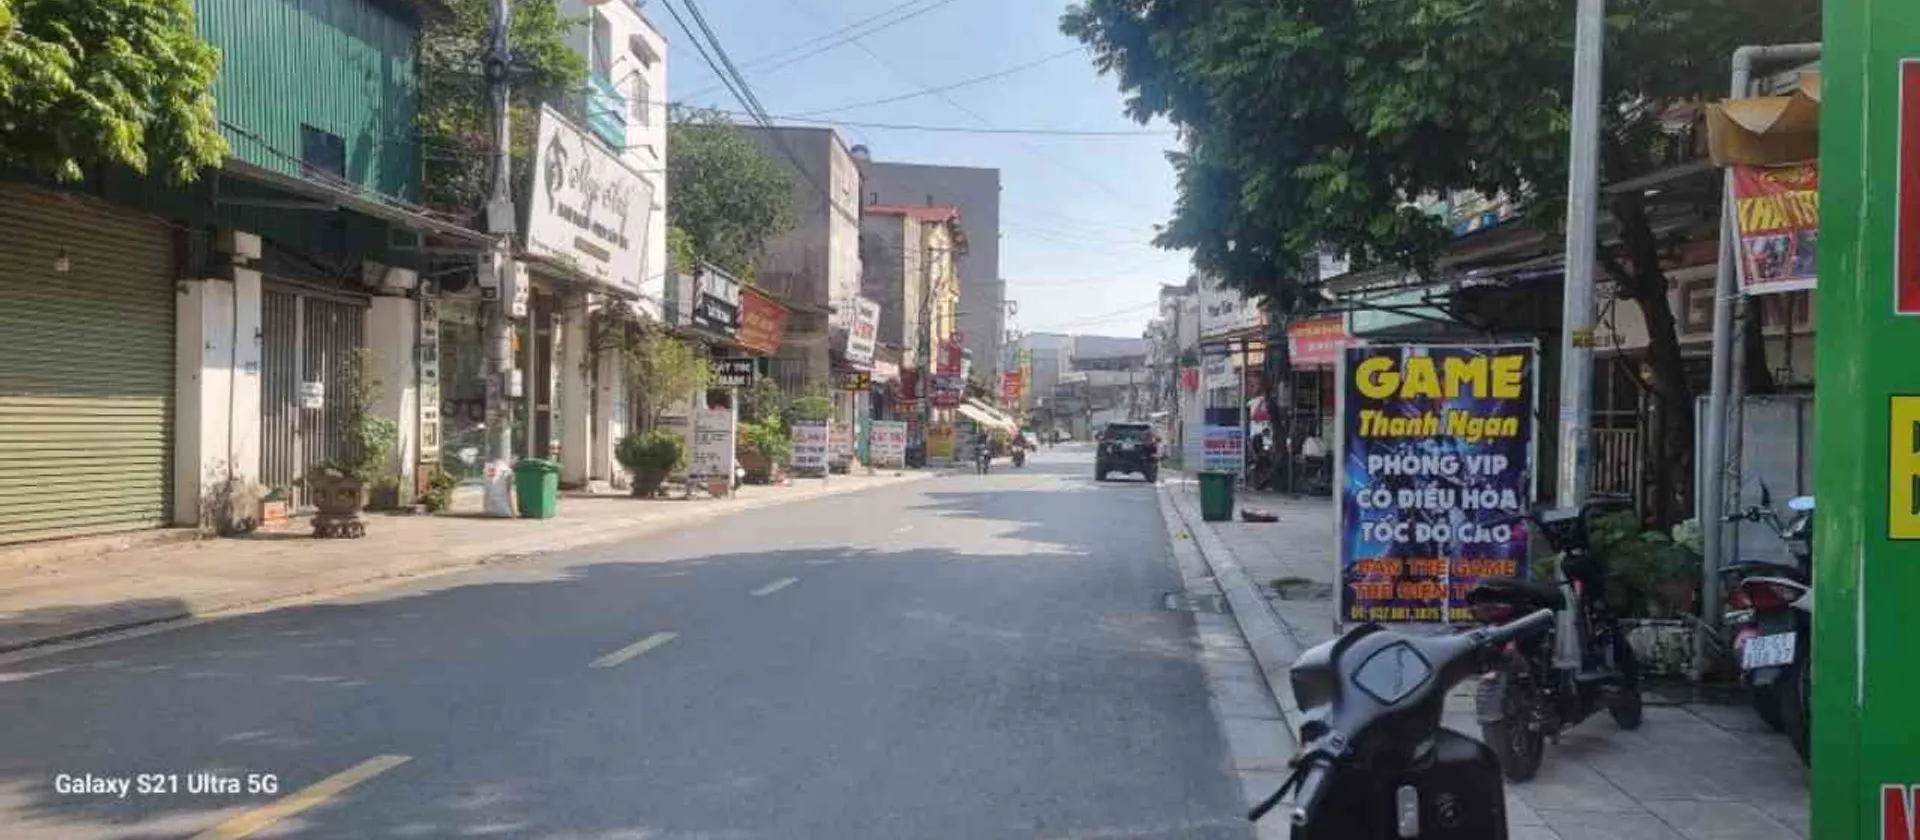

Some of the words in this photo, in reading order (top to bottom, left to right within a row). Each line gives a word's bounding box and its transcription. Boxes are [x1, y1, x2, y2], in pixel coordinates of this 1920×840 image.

[1355, 354, 1524, 399] GAME
[1359, 410, 1440, 438] Thanh
[1465, 454, 1509, 476] VIP
[1361, 515, 1410, 544] TỐC
[1458, 522, 1512, 544] CAO
